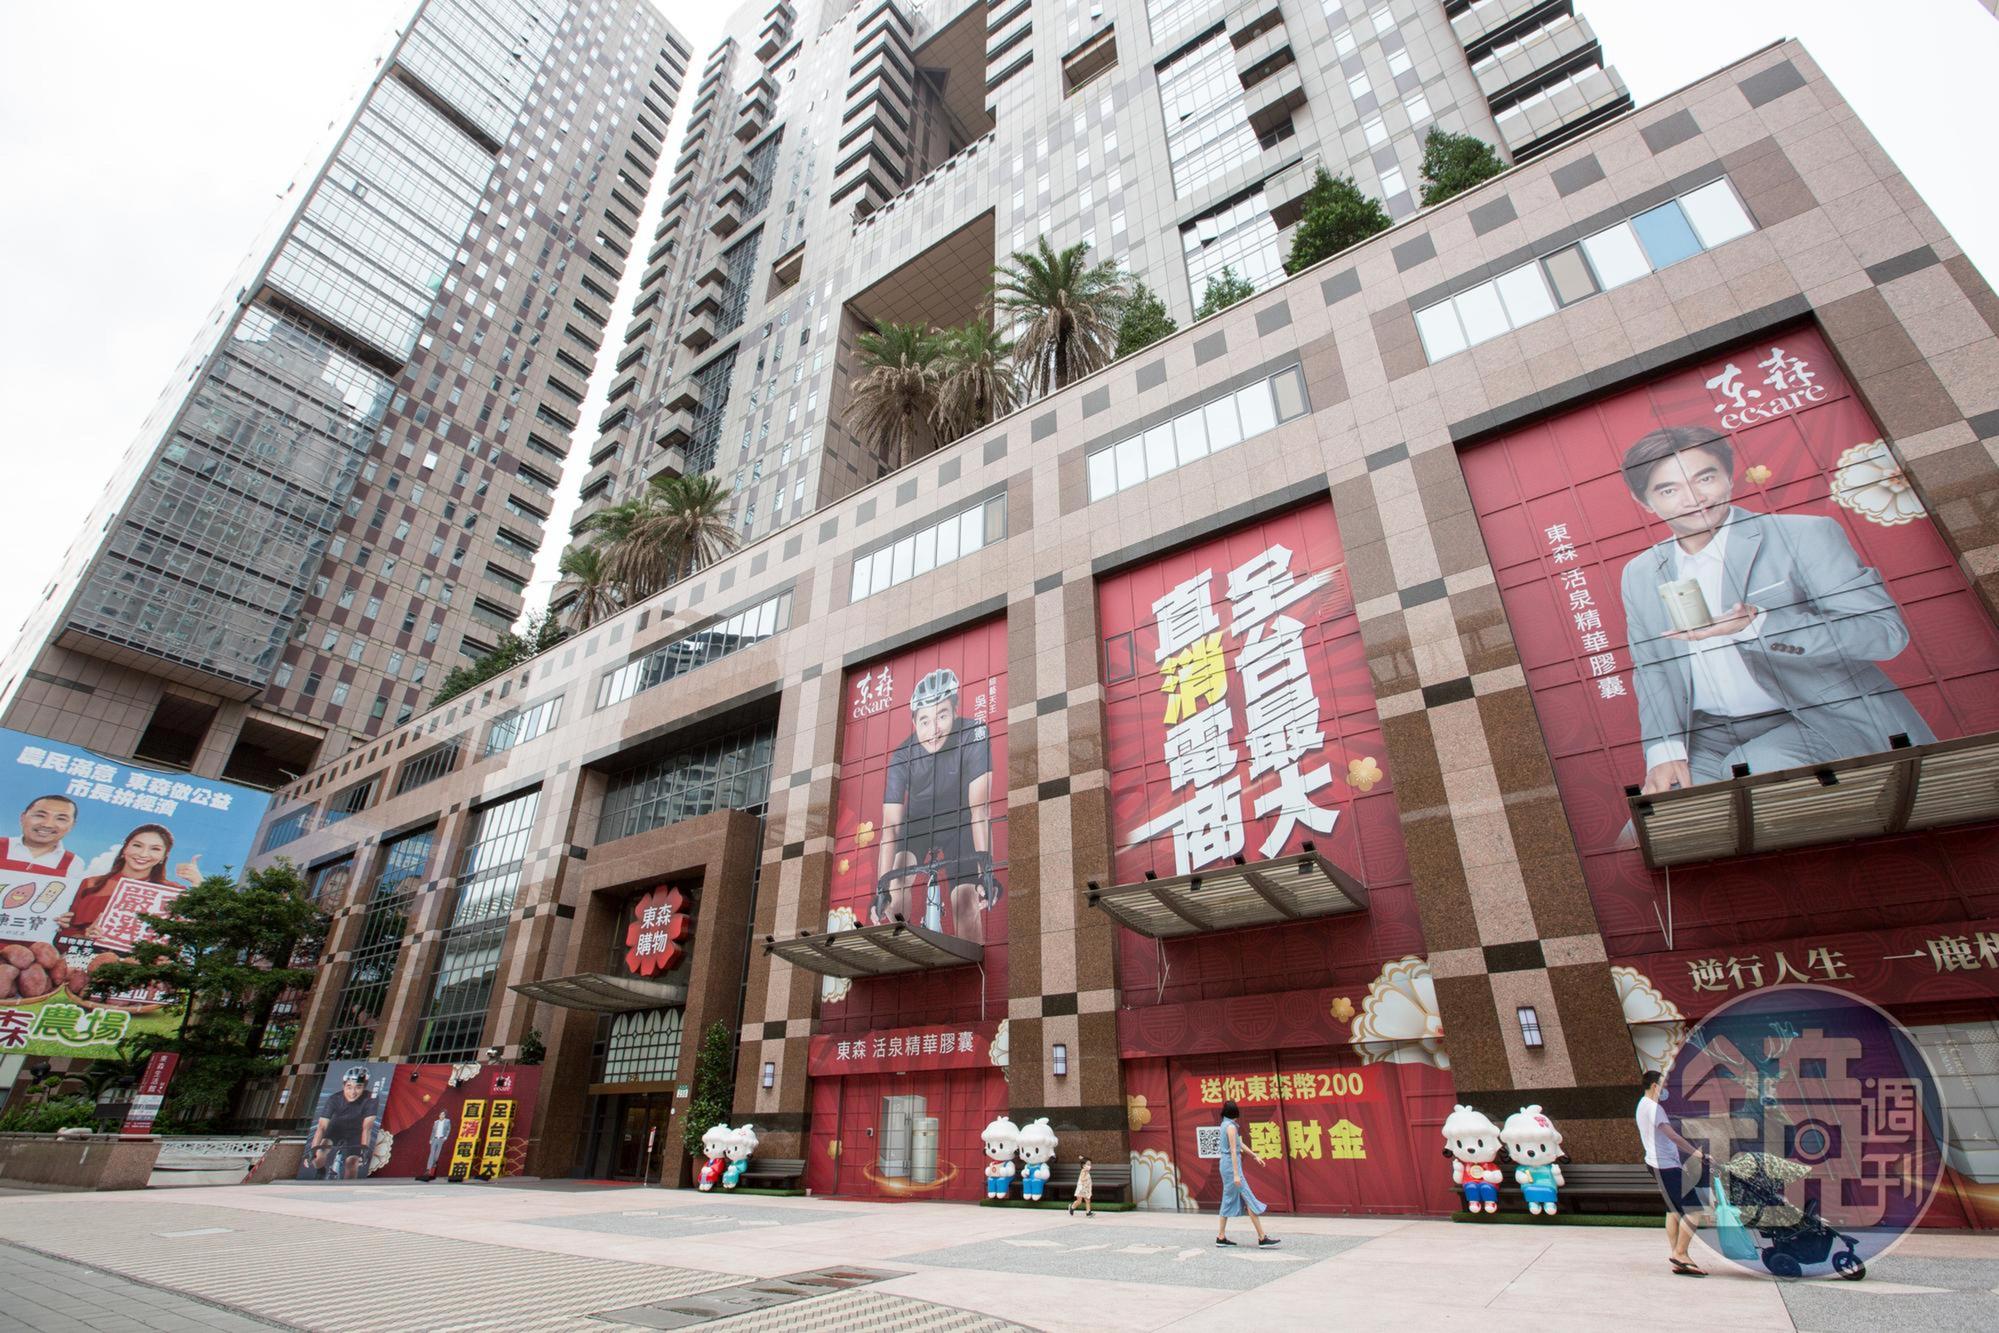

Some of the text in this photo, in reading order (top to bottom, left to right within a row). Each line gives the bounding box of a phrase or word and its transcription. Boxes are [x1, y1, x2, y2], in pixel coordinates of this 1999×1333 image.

[1545, 523, 1627, 699] 東森 活泉精華膠囊
[641, 903, 672, 929] 東森
[636, 930, 668, 956] 購物
[1686, 947, 1855, 993] 逆行人生
[836, 1031, 974, 1060] 東森 活泉精華膠囊
[1200, 1072, 1364, 1103] 送你東森幣200
[1249, 1119, 1366, 1160] 發財金
